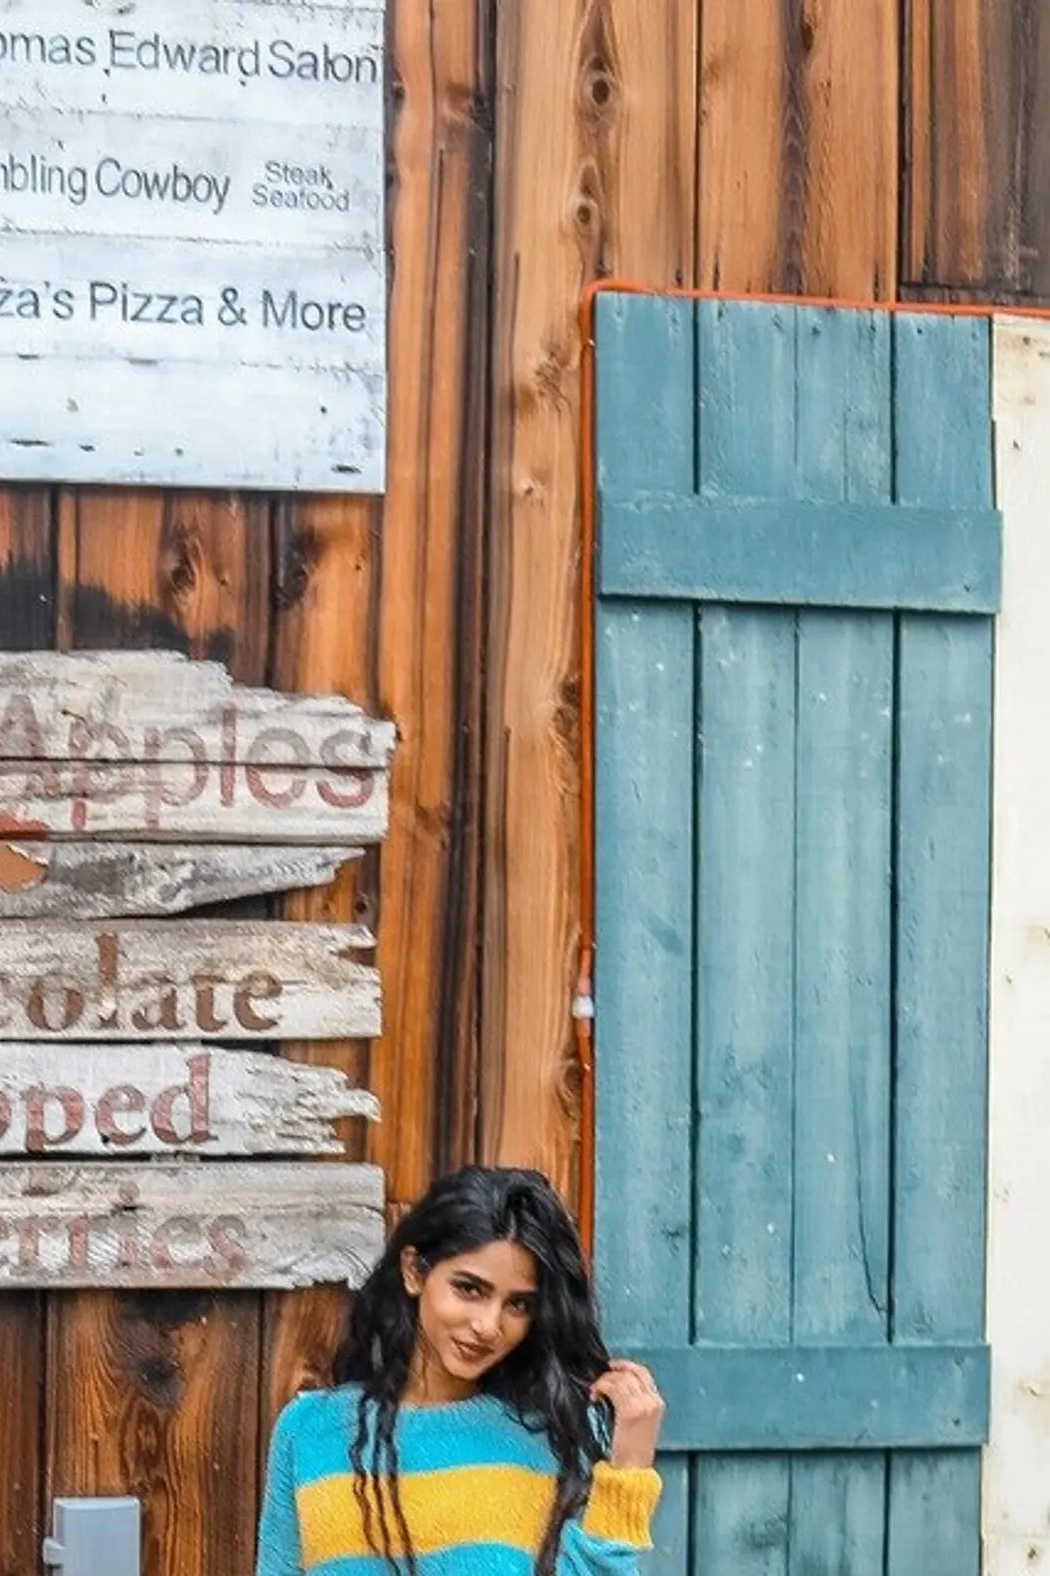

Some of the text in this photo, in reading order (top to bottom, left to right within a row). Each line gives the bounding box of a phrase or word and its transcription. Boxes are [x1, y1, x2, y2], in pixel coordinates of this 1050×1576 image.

[108, 29, 261, 78] Edward
[269, 40, 377, 84] Salon
[96, 157, 230, 215] Cowboy
[251, 181, 350, 213] Seafood
[265, 159, 334, 190] Steak
[90, 281, 205, 326] Pizza
[217, 287, 248, 326] &
[261, 288, 367, 332] More
